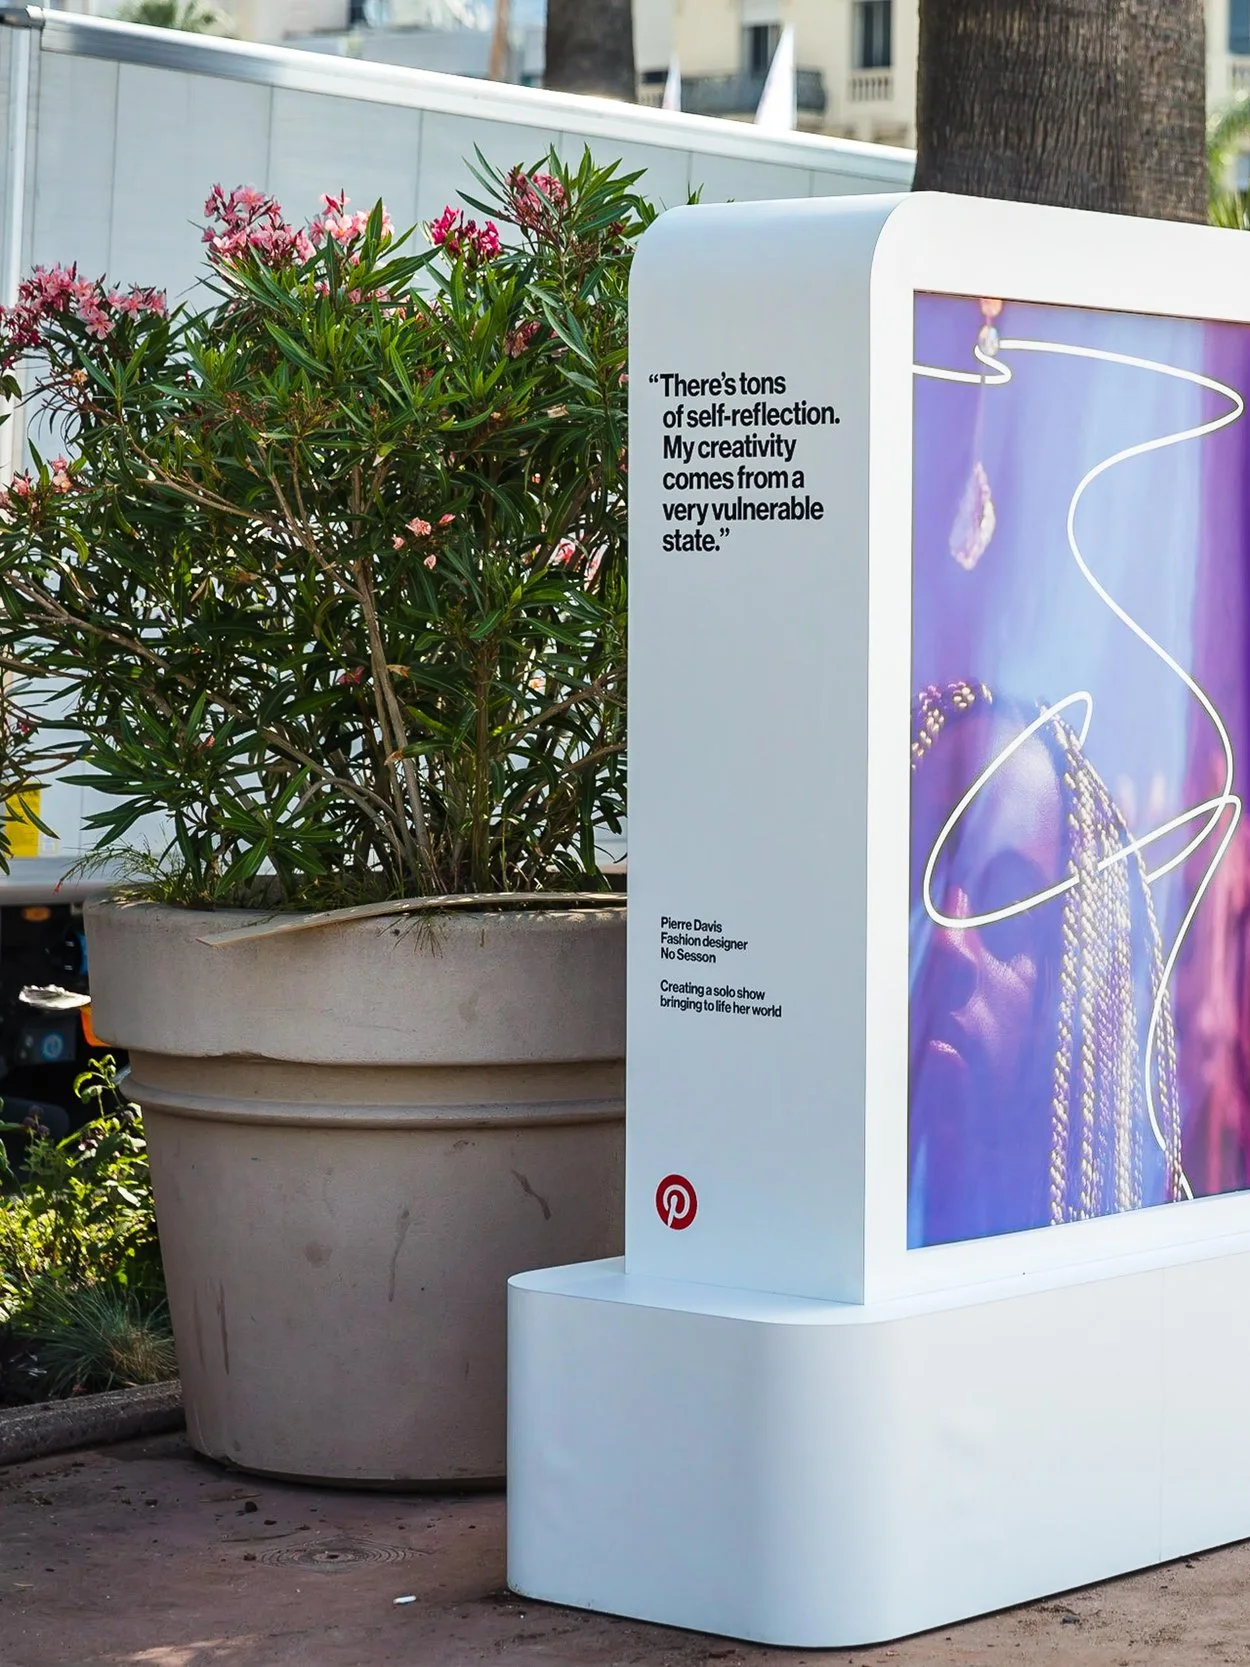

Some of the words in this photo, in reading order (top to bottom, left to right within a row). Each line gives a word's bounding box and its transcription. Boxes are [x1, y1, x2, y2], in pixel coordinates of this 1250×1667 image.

[739, 372, 786, 395] tons
[662, 404, 684, 428] of
[686, 400, 841, 428] self-reflection.
[663, 435, 694, 464] My
[698, 433, 797, 462] creativity
[662, 471, 734, 490] comes
[737, 465, 789, 489] from
[791, 470, 805, 488] a
[662, 502, 709, 526] very
[711, 495, 824, 520] vulnerable
[661, 916, 692, 931] Pierre
[694, 919, 722, 933] Davis
[661, 932, 701, 947] Fashion
[702, 935, 748, 951] designer
[661, 947, 676, 960] No
[676, 948, 716, 963] Sesson
[660, 979, 705, 997] Creating
[705, 986, 713, 996] a
[713, 985, 736, 998] solo
[737, 987, 765, 1000] show
[660, 995, 703, 1013] bringing
[703, 999, 715, 1011] to
[715, 1000, 732, 1013] life
[733, 1001, 751, 1015] her
[752, 1005, 782, 1018] world
